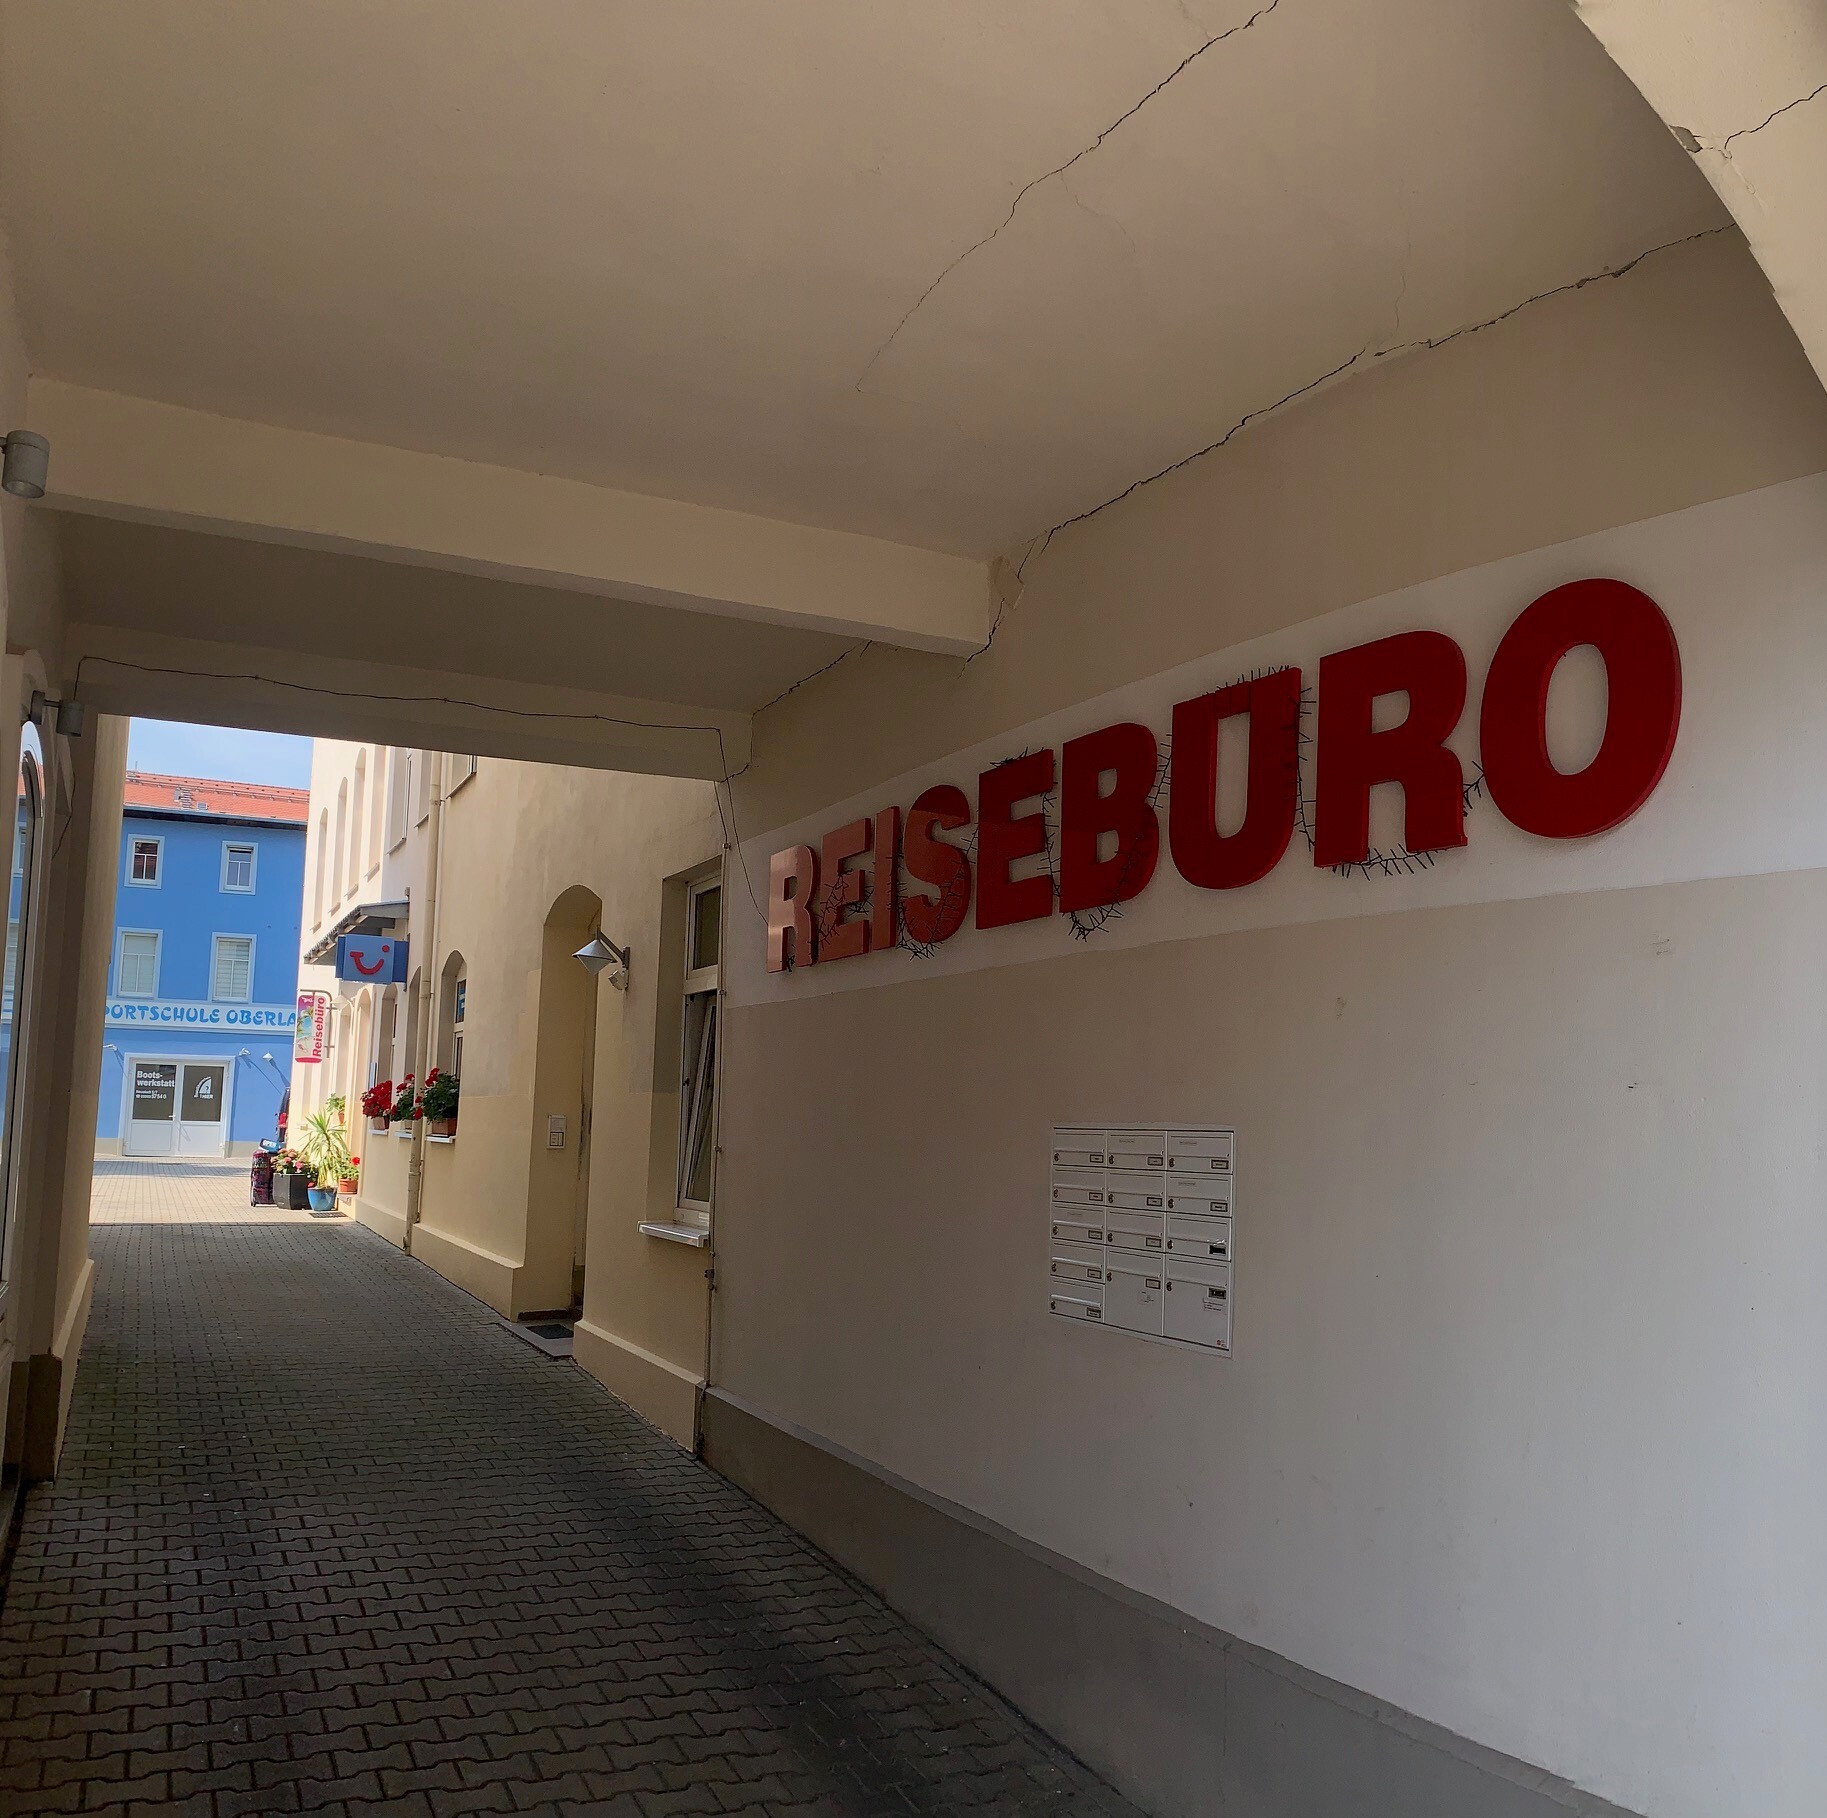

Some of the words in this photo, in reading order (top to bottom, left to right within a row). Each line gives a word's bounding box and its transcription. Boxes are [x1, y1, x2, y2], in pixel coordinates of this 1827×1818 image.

[767, 577, 1683, 974] REISEBÜRO
[312, 997, 326, 1058] Reisebüro
[137, 1070, 163, 1079] Boots-
[137, 1079, 175, 1088] werkstatt
